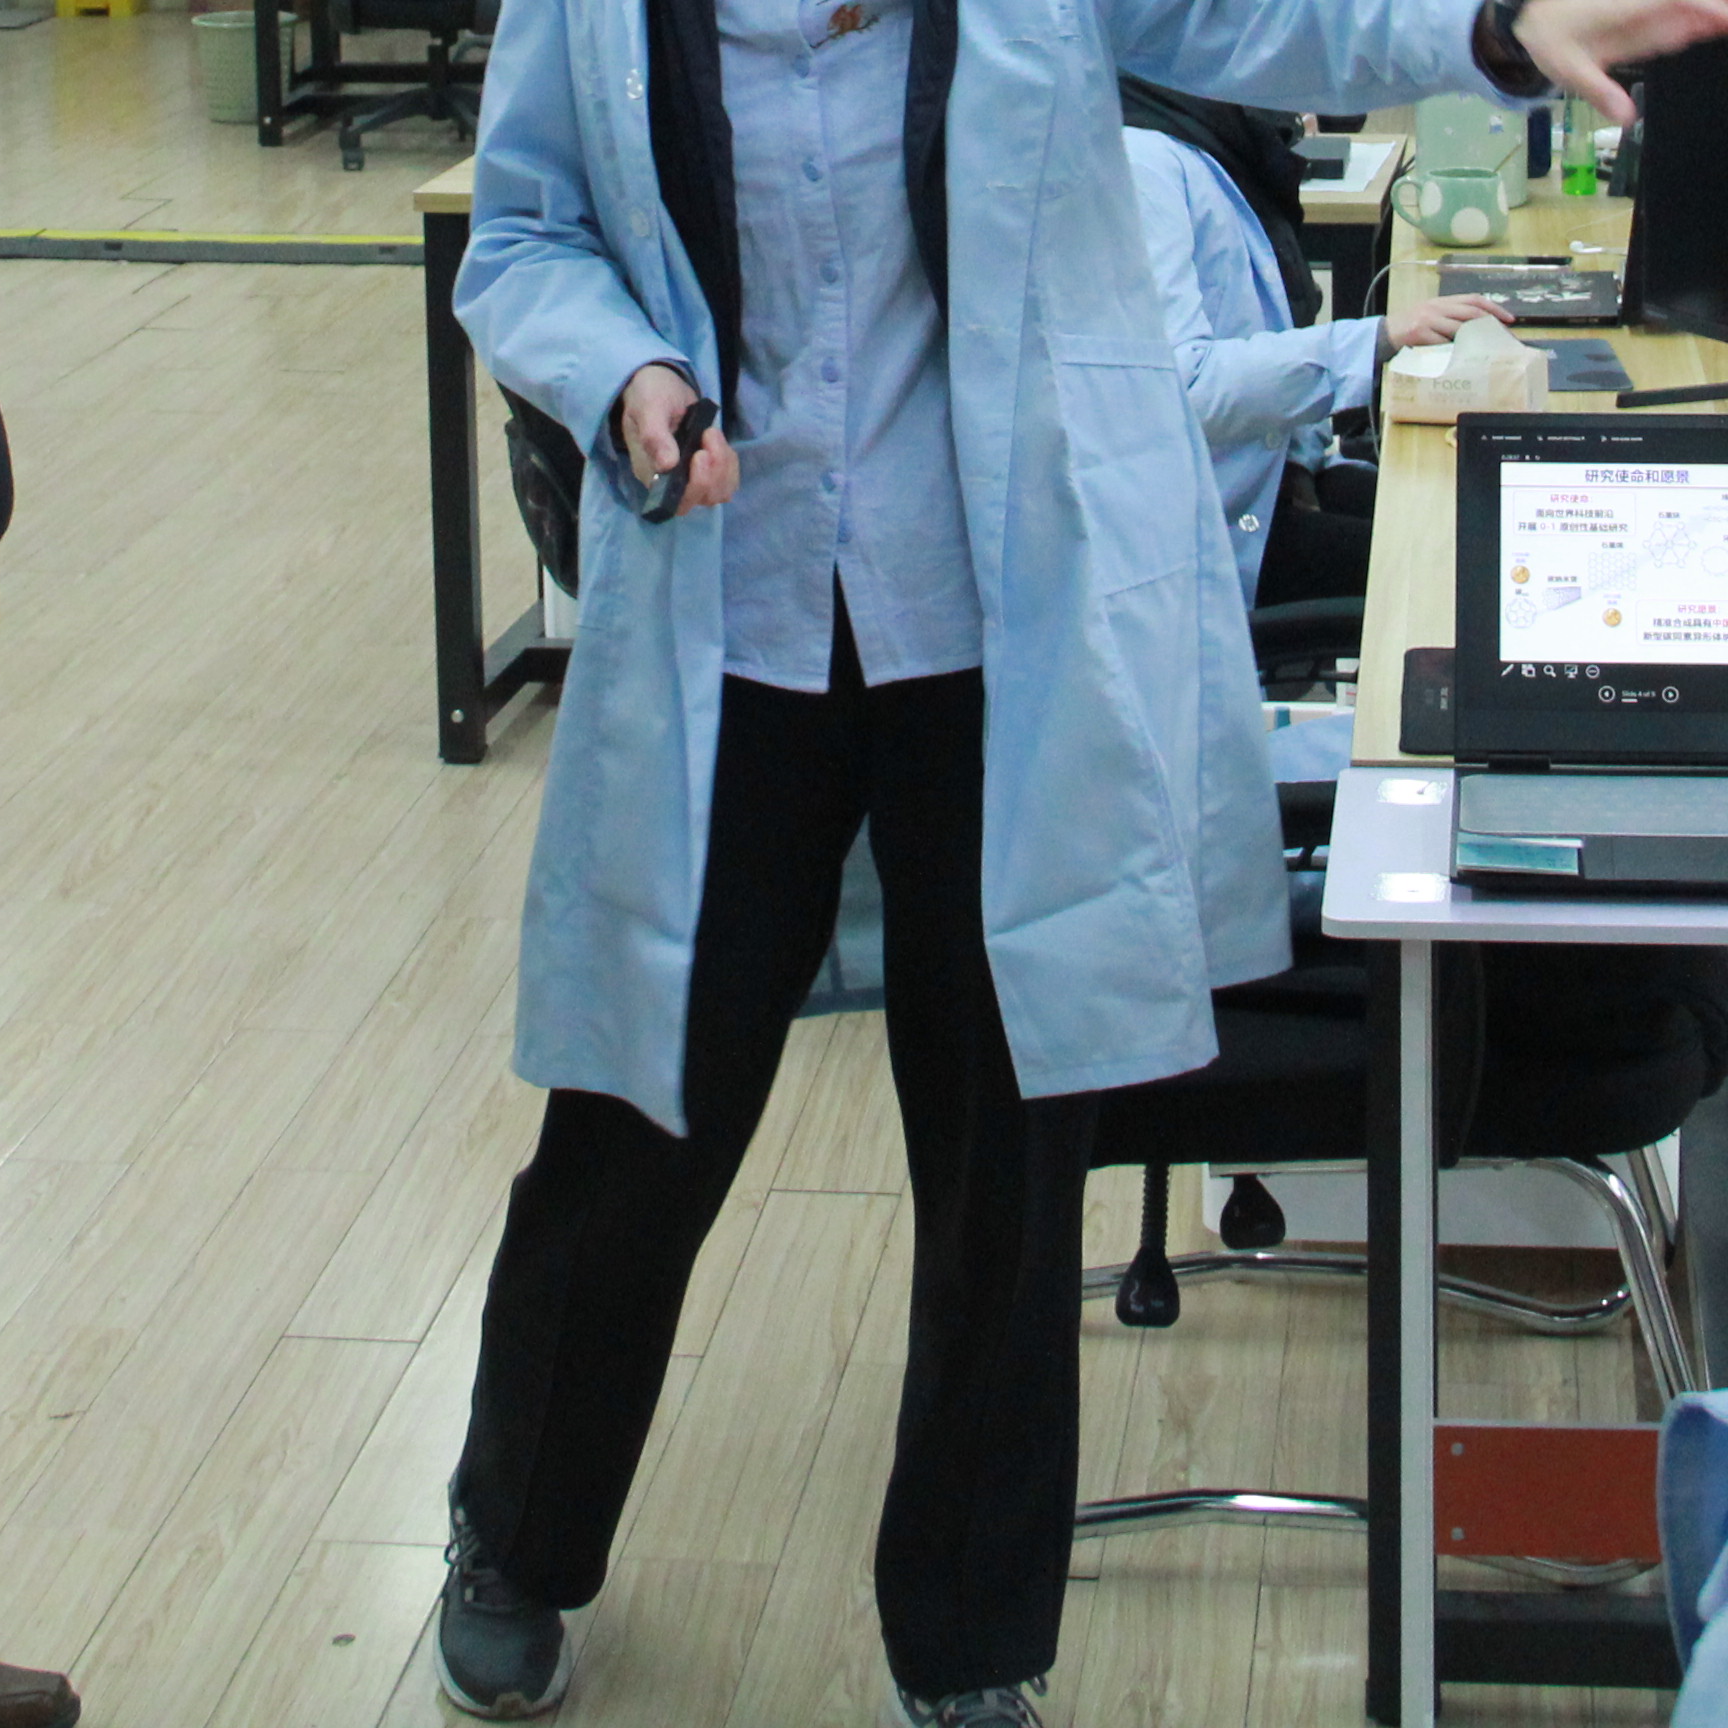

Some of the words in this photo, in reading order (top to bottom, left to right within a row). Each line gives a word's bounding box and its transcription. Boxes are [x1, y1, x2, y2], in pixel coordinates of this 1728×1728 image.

[1432, 378, 1471, 390] Face
[1584, 469, 1690, 484] 研究使命和愿景
[1535, 508, 1614, 519] 面向世界科技前沿
[1559, 522, 1629, 532] 原创性基础研究
